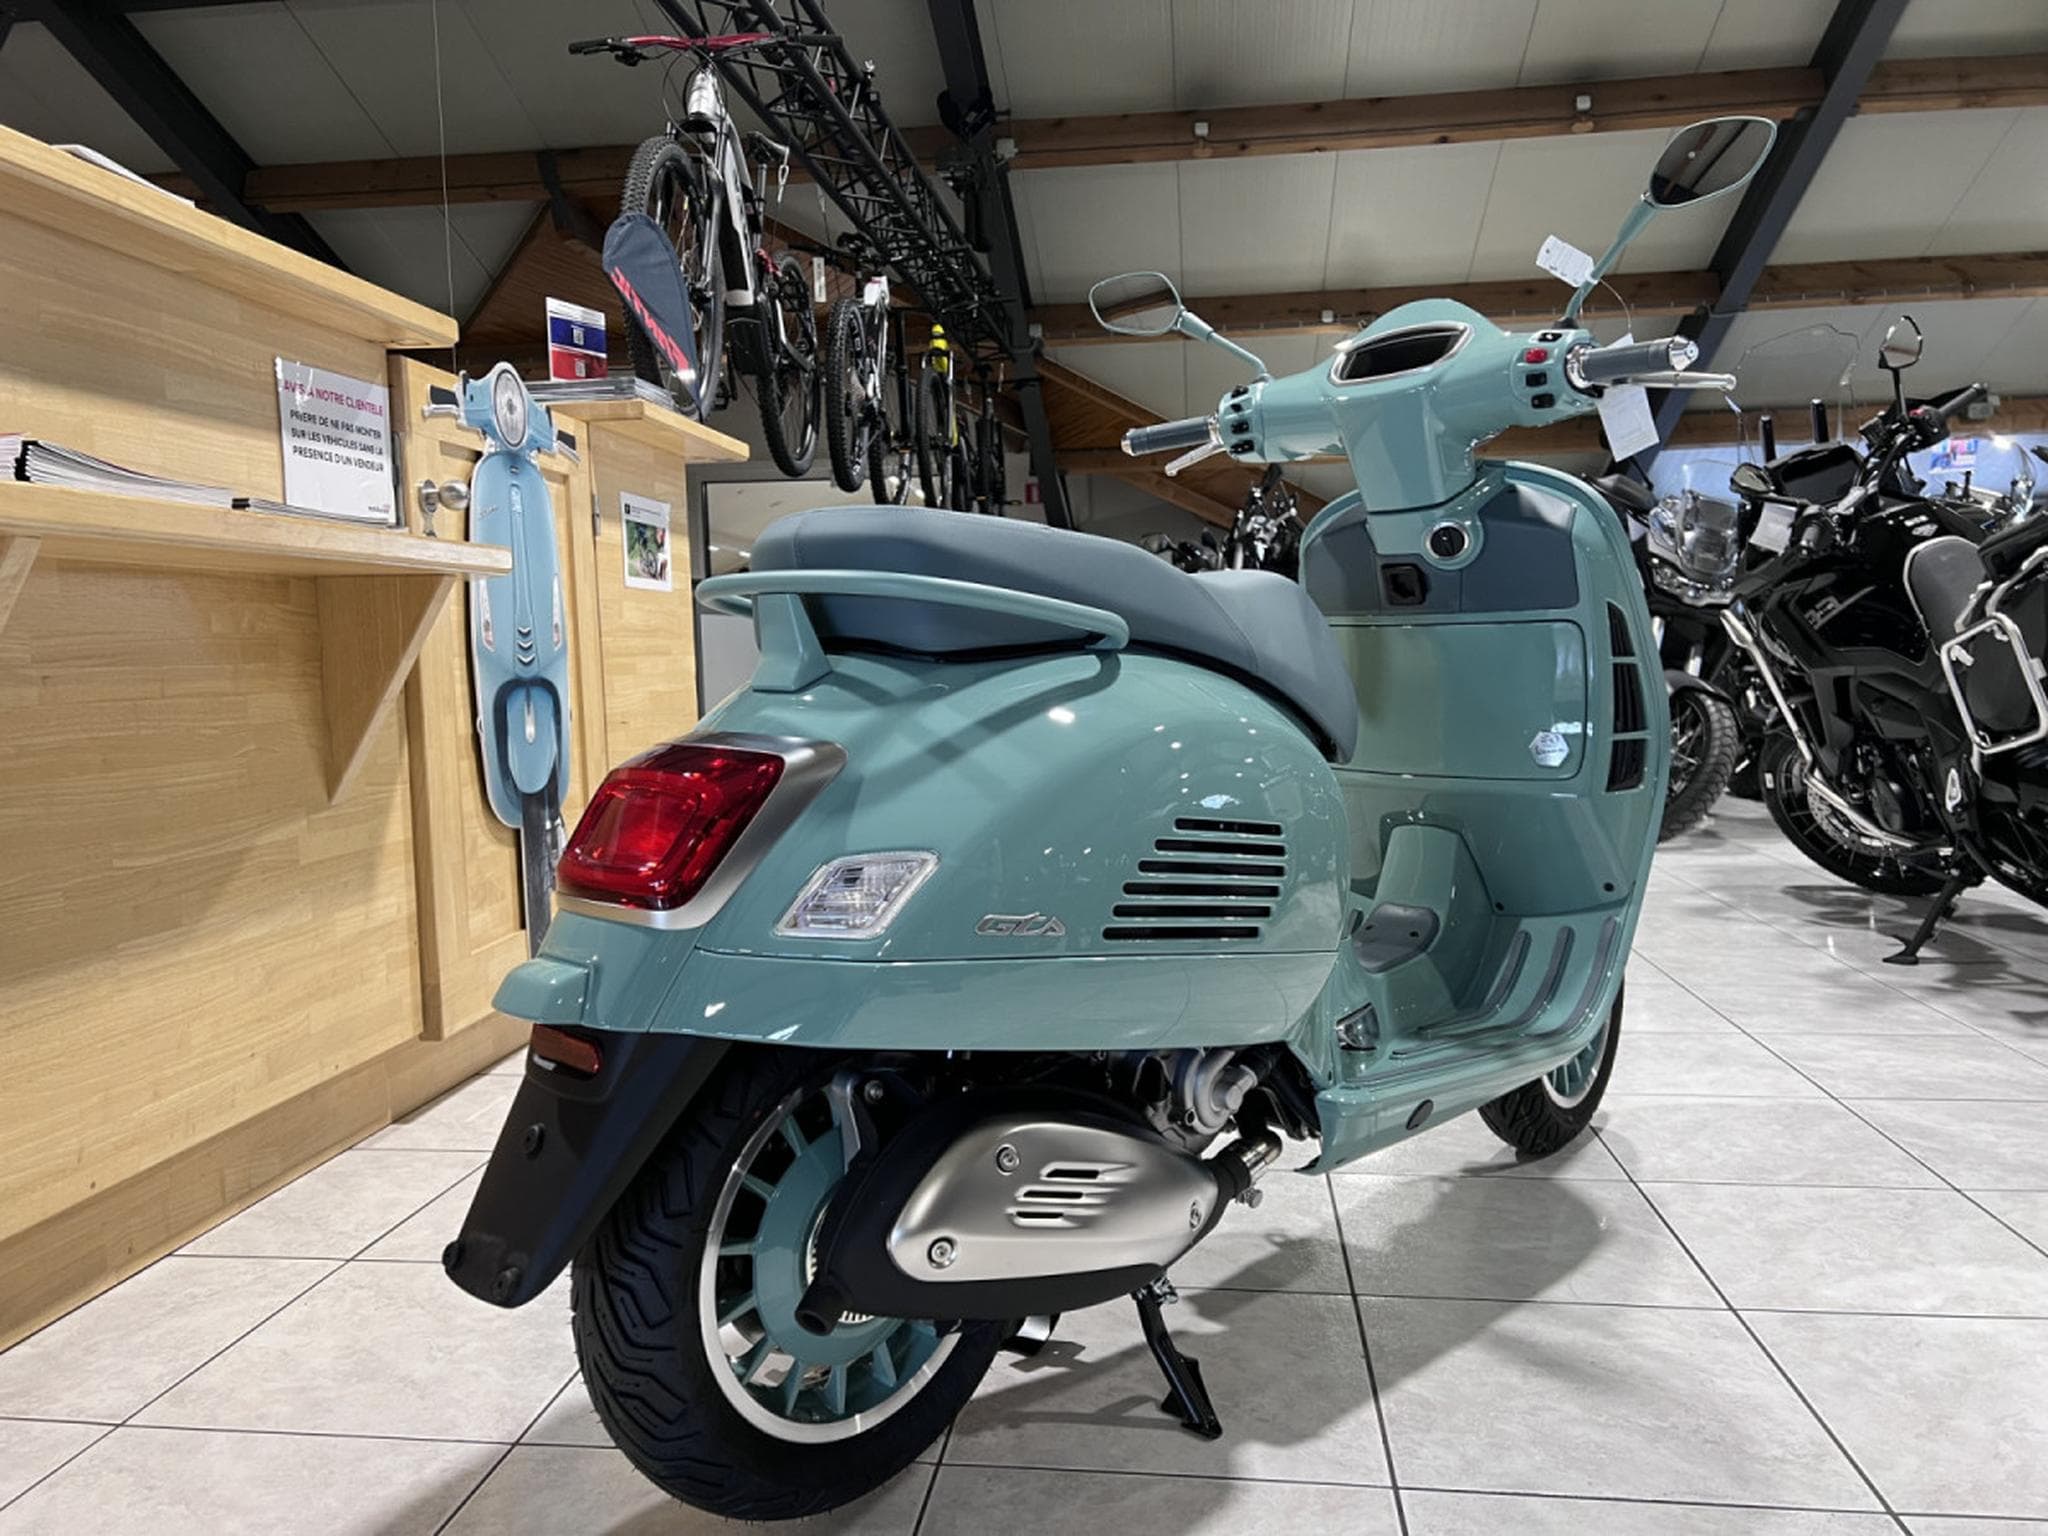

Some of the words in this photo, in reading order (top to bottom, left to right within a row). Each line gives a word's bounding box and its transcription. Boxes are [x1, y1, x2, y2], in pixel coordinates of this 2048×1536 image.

[315, 387, 344, 405] NOTRE
[319, 416, 329, 427] DE
[330, 419, 340, 431] NE
[341, 420, 354, 433] PAS
[355, 425, 382, 440] MONTER
[291, 427, 306, 439] SUR
[308, 430, 321, 443] LES
[358, 442, 374, 455] SANS
[375, 447, 383, 455] LA
[353, 457, 384, 472] VENDEUR
